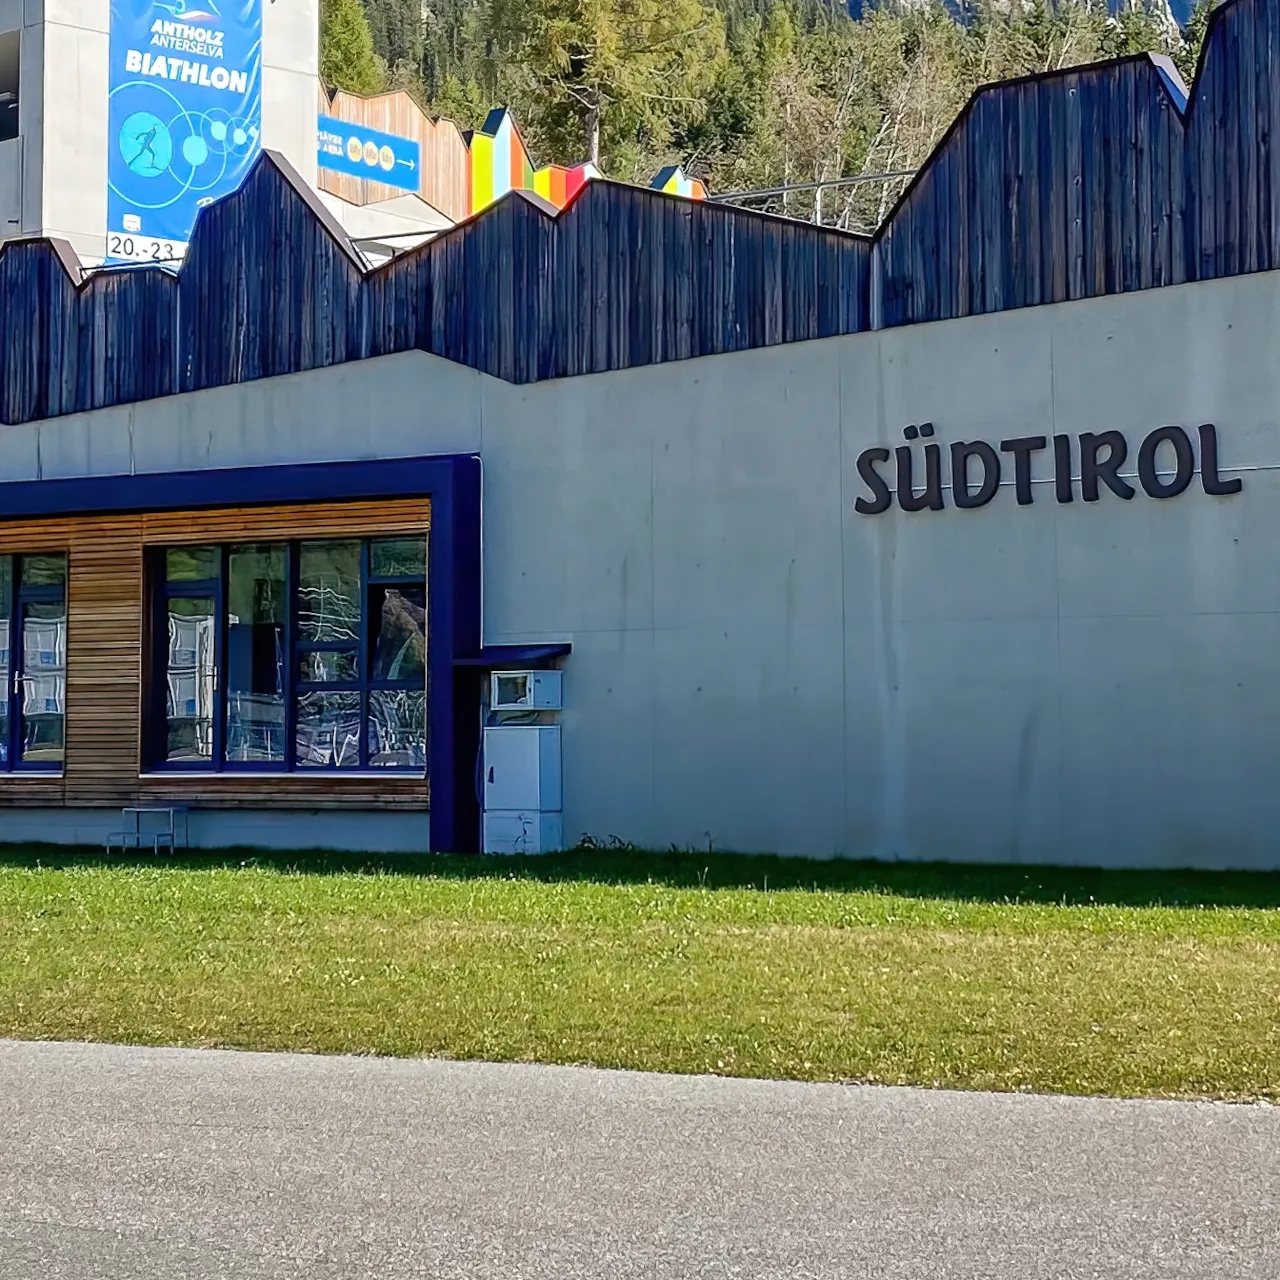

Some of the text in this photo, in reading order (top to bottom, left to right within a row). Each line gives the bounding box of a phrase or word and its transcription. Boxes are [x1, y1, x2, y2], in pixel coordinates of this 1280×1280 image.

[149, 33, 224, 59] ANTERSELVA
[150, 19, 225, 47] ANTHOLZ
[125, 49, 248, 94] BIATHLON
[853, 423, 1243, 515] SÜDTIROL
